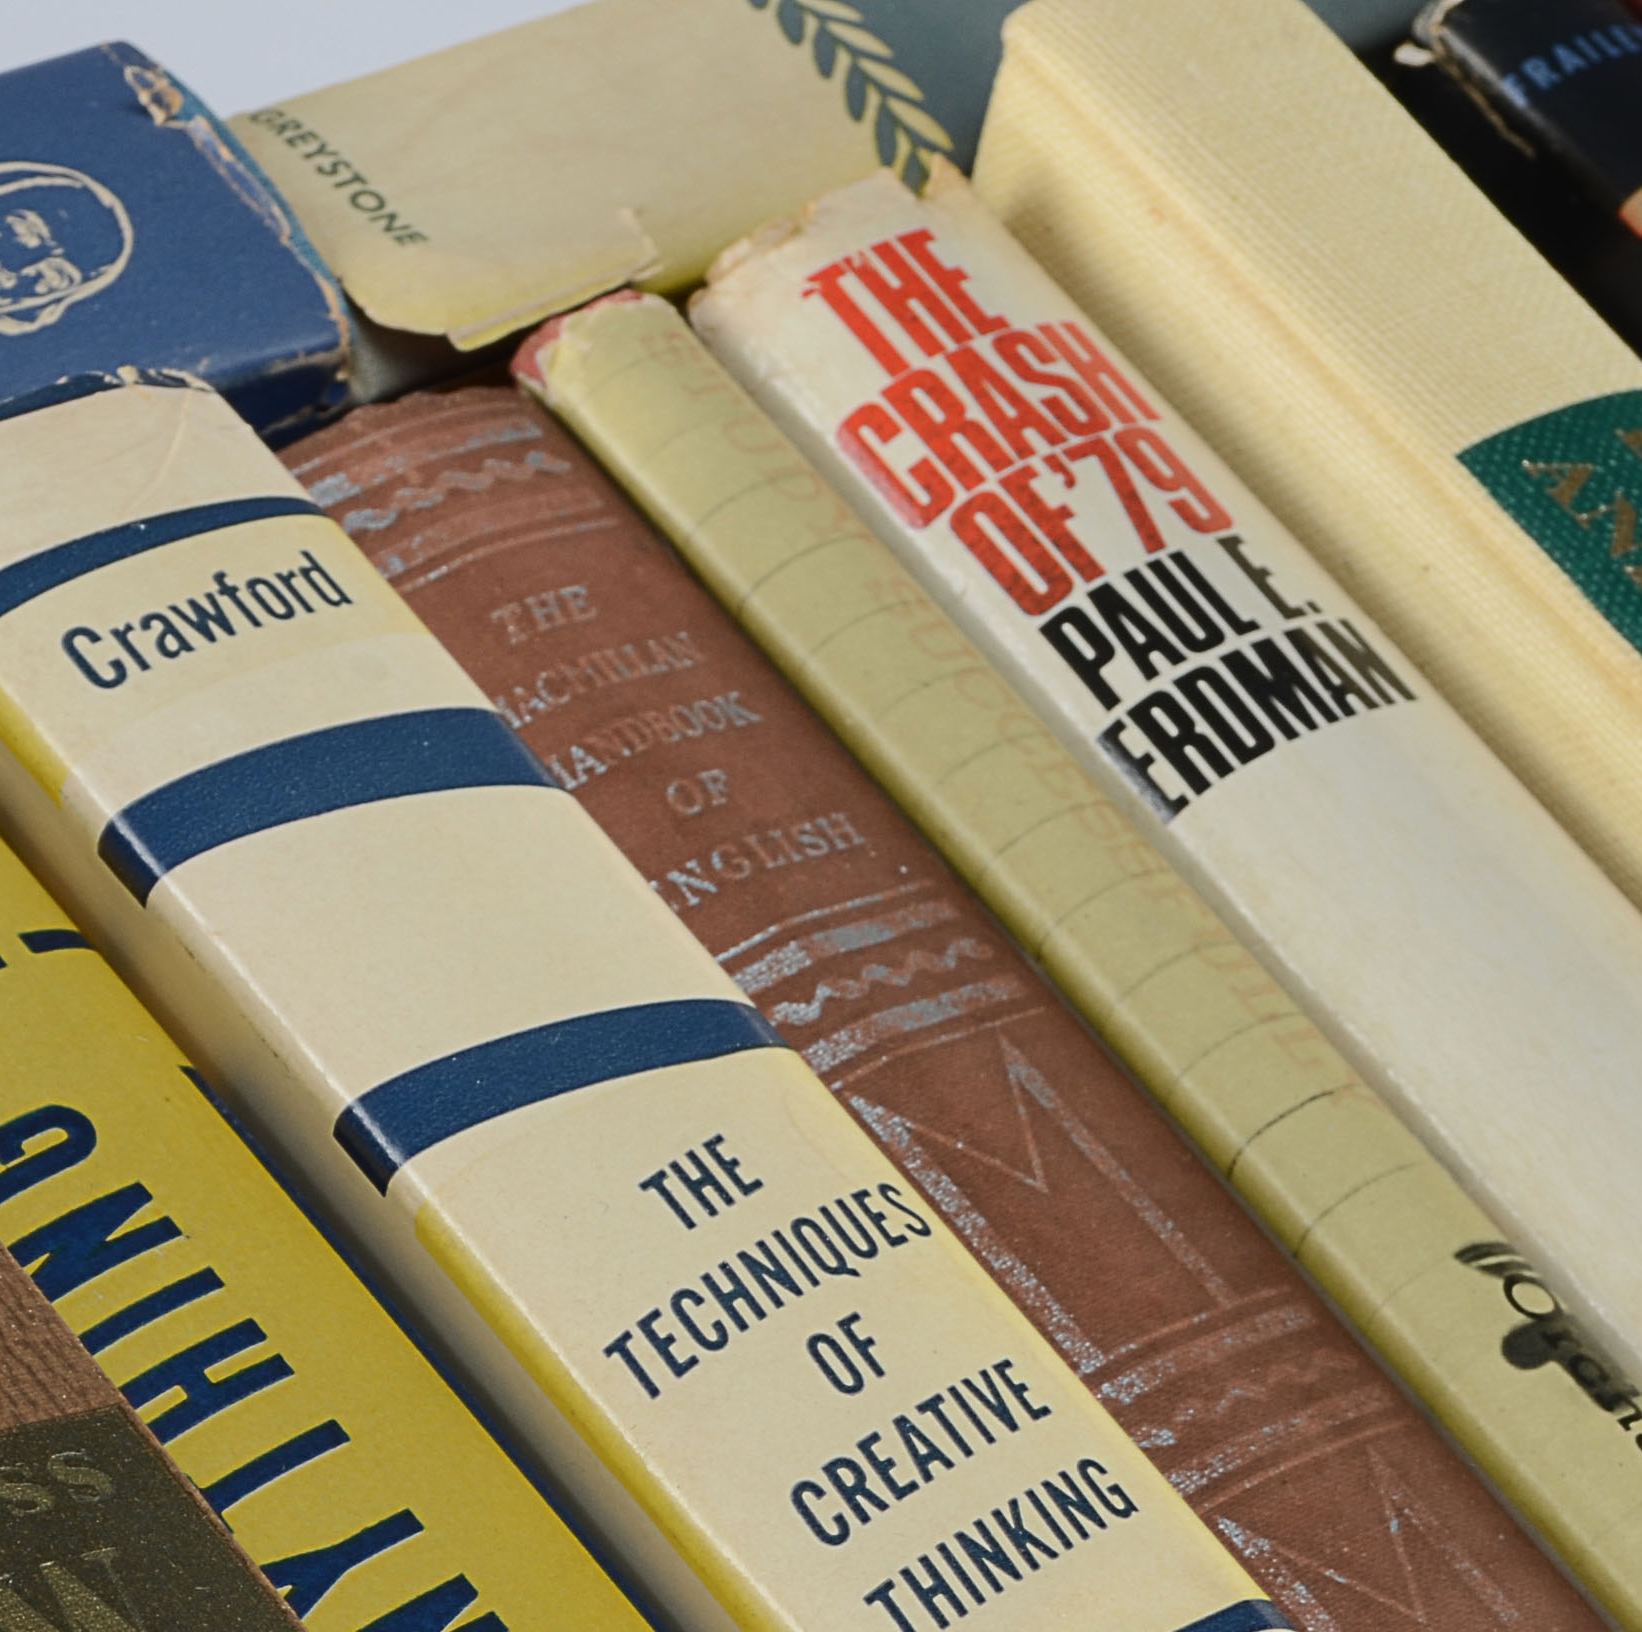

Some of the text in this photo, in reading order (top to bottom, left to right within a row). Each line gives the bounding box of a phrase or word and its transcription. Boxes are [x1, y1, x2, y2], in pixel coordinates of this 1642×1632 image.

[249, 108, 430, 247] GREYSTONE
[802, 227, 1011, 377] THE
[834, 320, 1163, 531] CRASH
[60, 550, 353, 692] Crawford
[492, 585, 599, 645] THE
[1038, 534, 1322, 712] PAUL E.
[666, 768, 730, 815] OF
[1094, 617, 1419, 824] ERDMAN
[648, 812, 866, 912] NGLISH
[639, 1134, 765, 1230] THE
[602, 1182, 933, 1400] TECHNIQUES
[805, 1312, 887, 1396] OF
[789, 1359, 1052, 1547] CREATIVE
